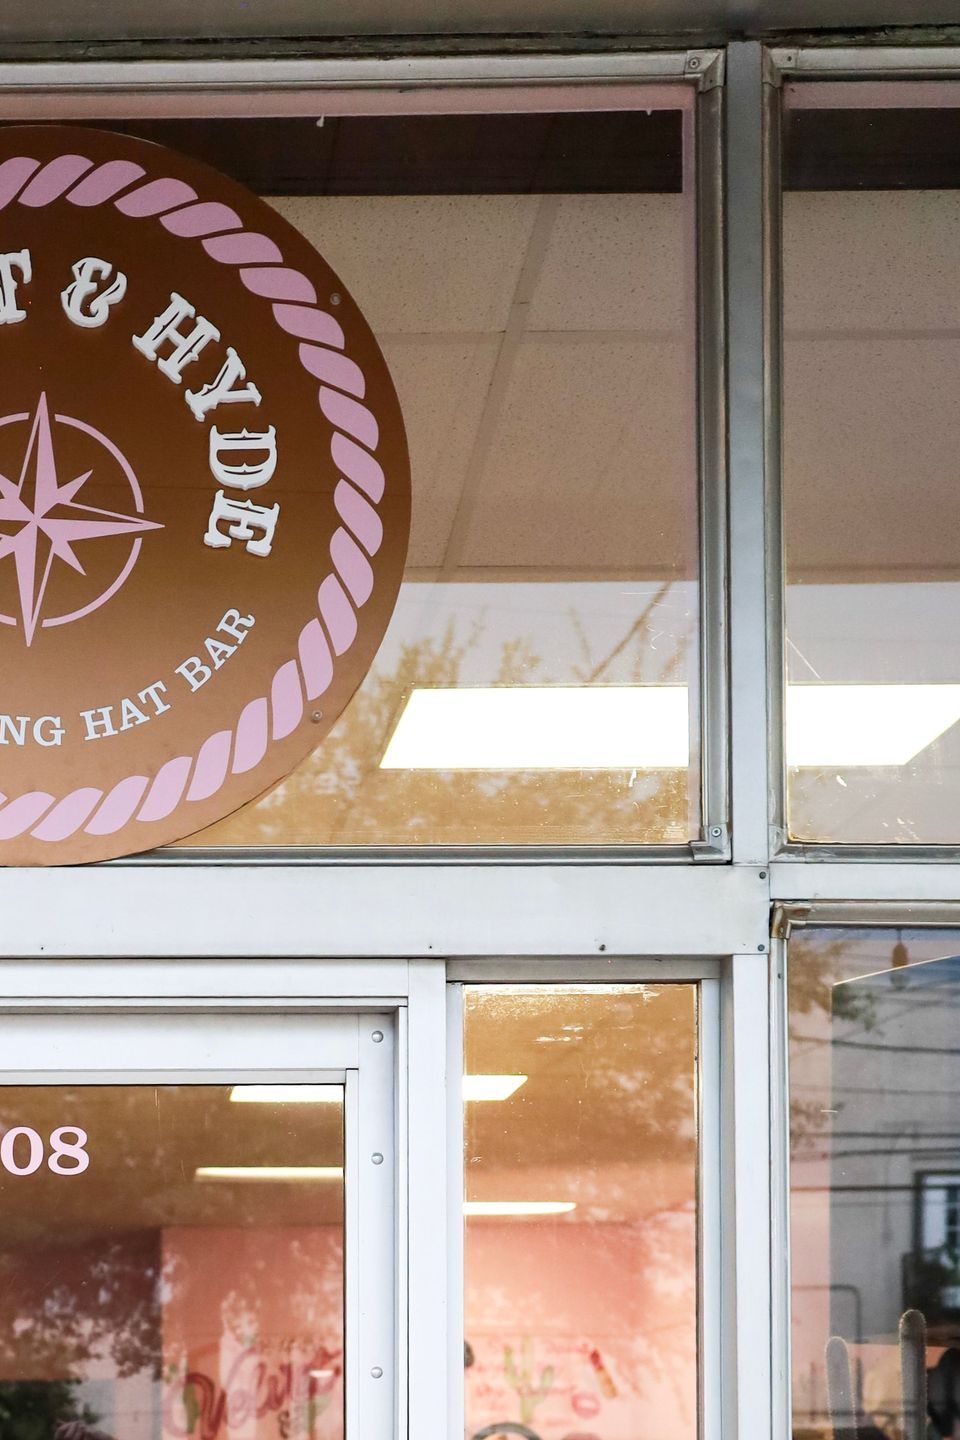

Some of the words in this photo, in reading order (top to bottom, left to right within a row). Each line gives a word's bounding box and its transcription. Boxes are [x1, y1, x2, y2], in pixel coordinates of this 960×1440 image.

[61, 257, 127, 327] &
[132, 292, 280, 557] HYDE
[79, 680, 172, 741] HAT
[174, 607, 256, 693] BAR
